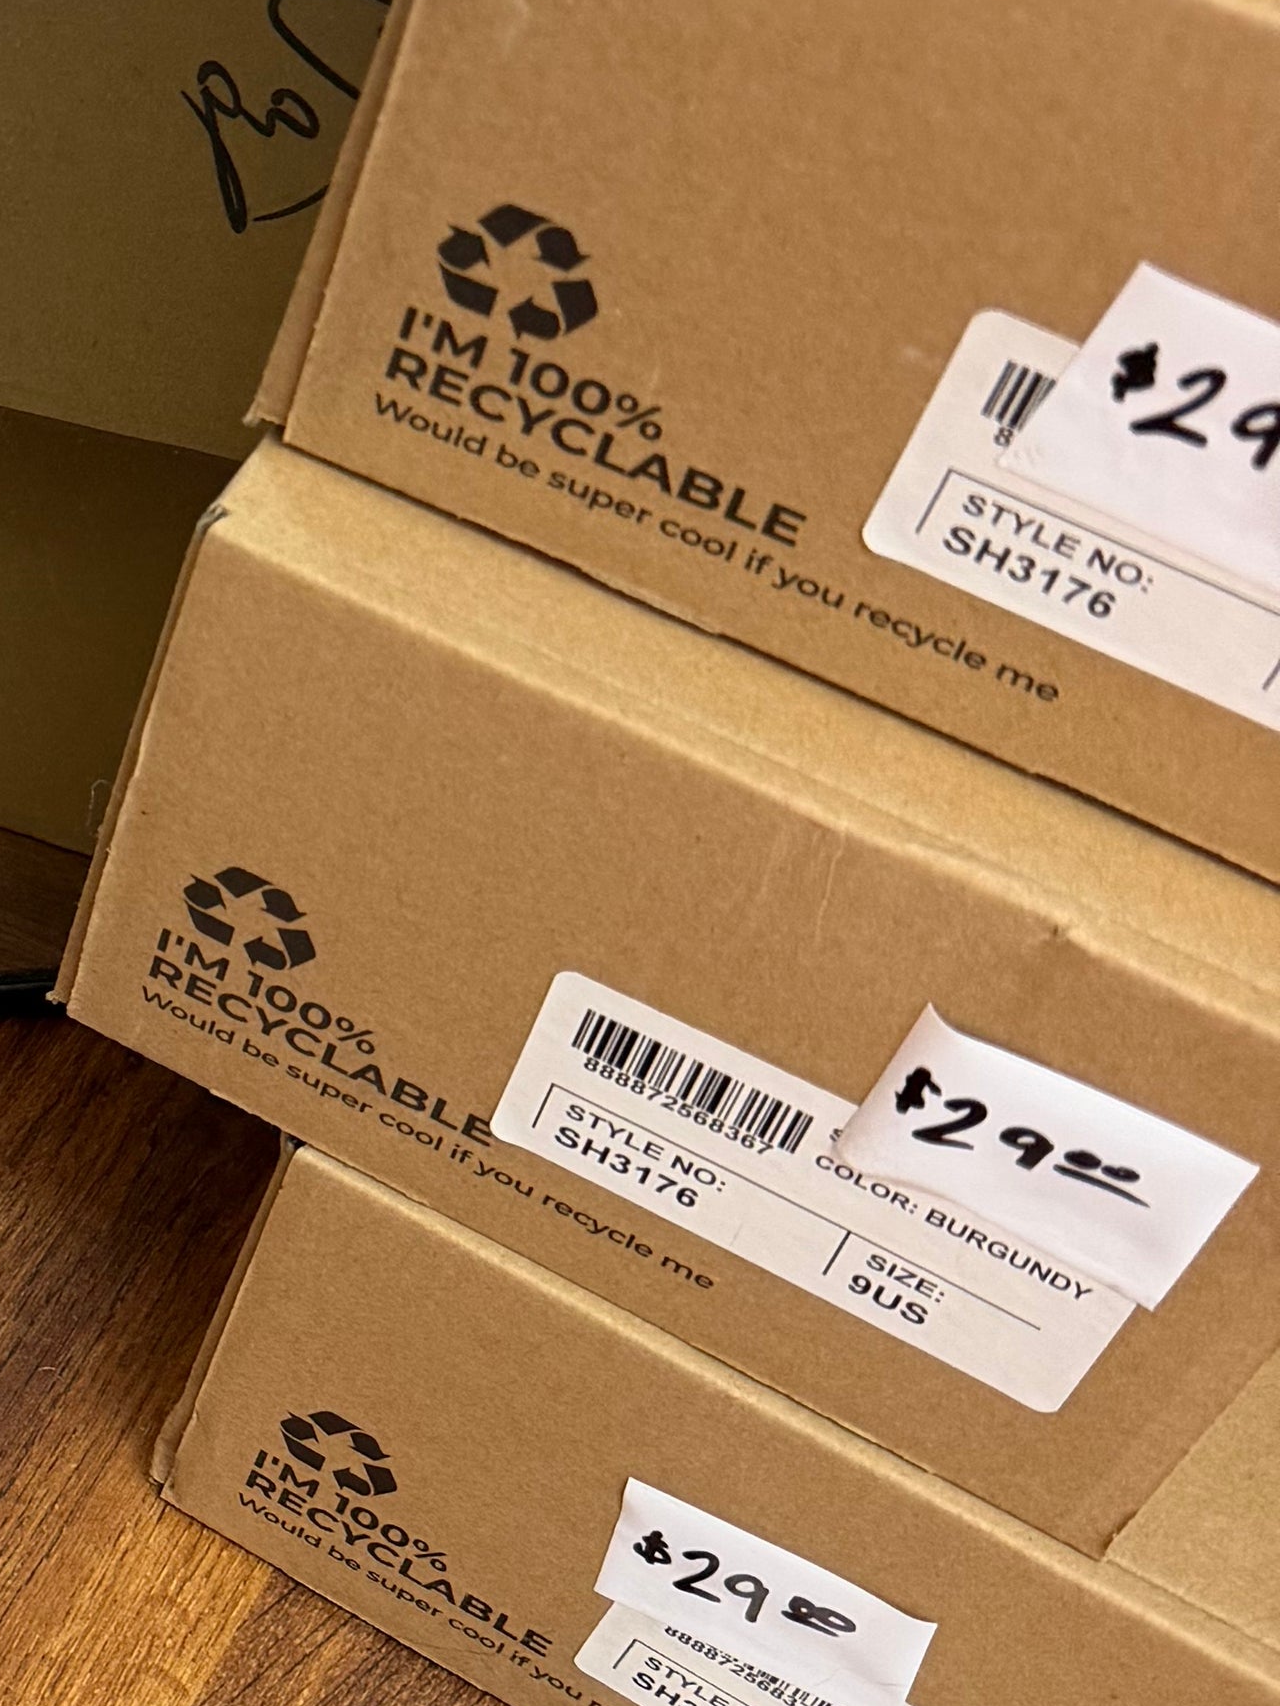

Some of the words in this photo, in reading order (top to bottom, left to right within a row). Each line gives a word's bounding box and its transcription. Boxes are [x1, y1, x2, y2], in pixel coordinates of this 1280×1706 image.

[399, 307, 488, 369] I'M
[507, 347, 664, 441] 100%
[385, 346, 808, 547] RECYCLABLE
[375, 393, 489, 458] Would
[496, 444, 539, 479] be
[548, 472, 652, 524] super
[660, 519, 738, 563] cool
[744, 550, 771, 576] if
[771, 563, 846, 609] you
[853, 601, 988, 671] recycle
[995, 660, 1060, 703] me
[942, 525, 1118, 619] SH3176
[962, 493, 1081, 560] STYLE
[1088, 548, 1154, 593] NO:
[148, 955, 495, 1147] RECYCLABLE
[155, 927, 230, 983] I'M
[246, 971, 377, 1057] 100%
[141, 986, 236, 1047] Would
[242, 1036, 280, 1067] be
[286, 1063, 373, 1115] super
[378, 1110, 444, 1152] cool
[449, 1142, 473, 1166] if
[470, 1158, 534, 1198] you
[541, 1192, 655, 1259] recycle
[661, 1253, 716, 1291] me
[554, 1125, 700, 1210] SH3176
[564, 1102, 666, 1161] STYLE
[670, 1154, 727, 1193] NO:
[582, 1056, 776, 1157] 888872568367
[814, 1153, 919, 1219] COLOR:
[924, 1206, 1093, 1300] BURGUNDY
[865, 1252, 947, 1304] SIZE:
[847, 1274, 930, 1326] 9US
[244, 1470, 554, 1658] RECYCLABLE
[253, 1450, 322, 1498] I'M
[333, 1494, 448, 1573] 100%
[238, 1492, 322, 1549] Would
[328, 1540, 362, 1571] be
[366, 1567, 444, 1618] super
[448, 1615, 505, 1655] cool
[509, 1647, 531, 1668] if
[529, 1664, 583, 1702] you
